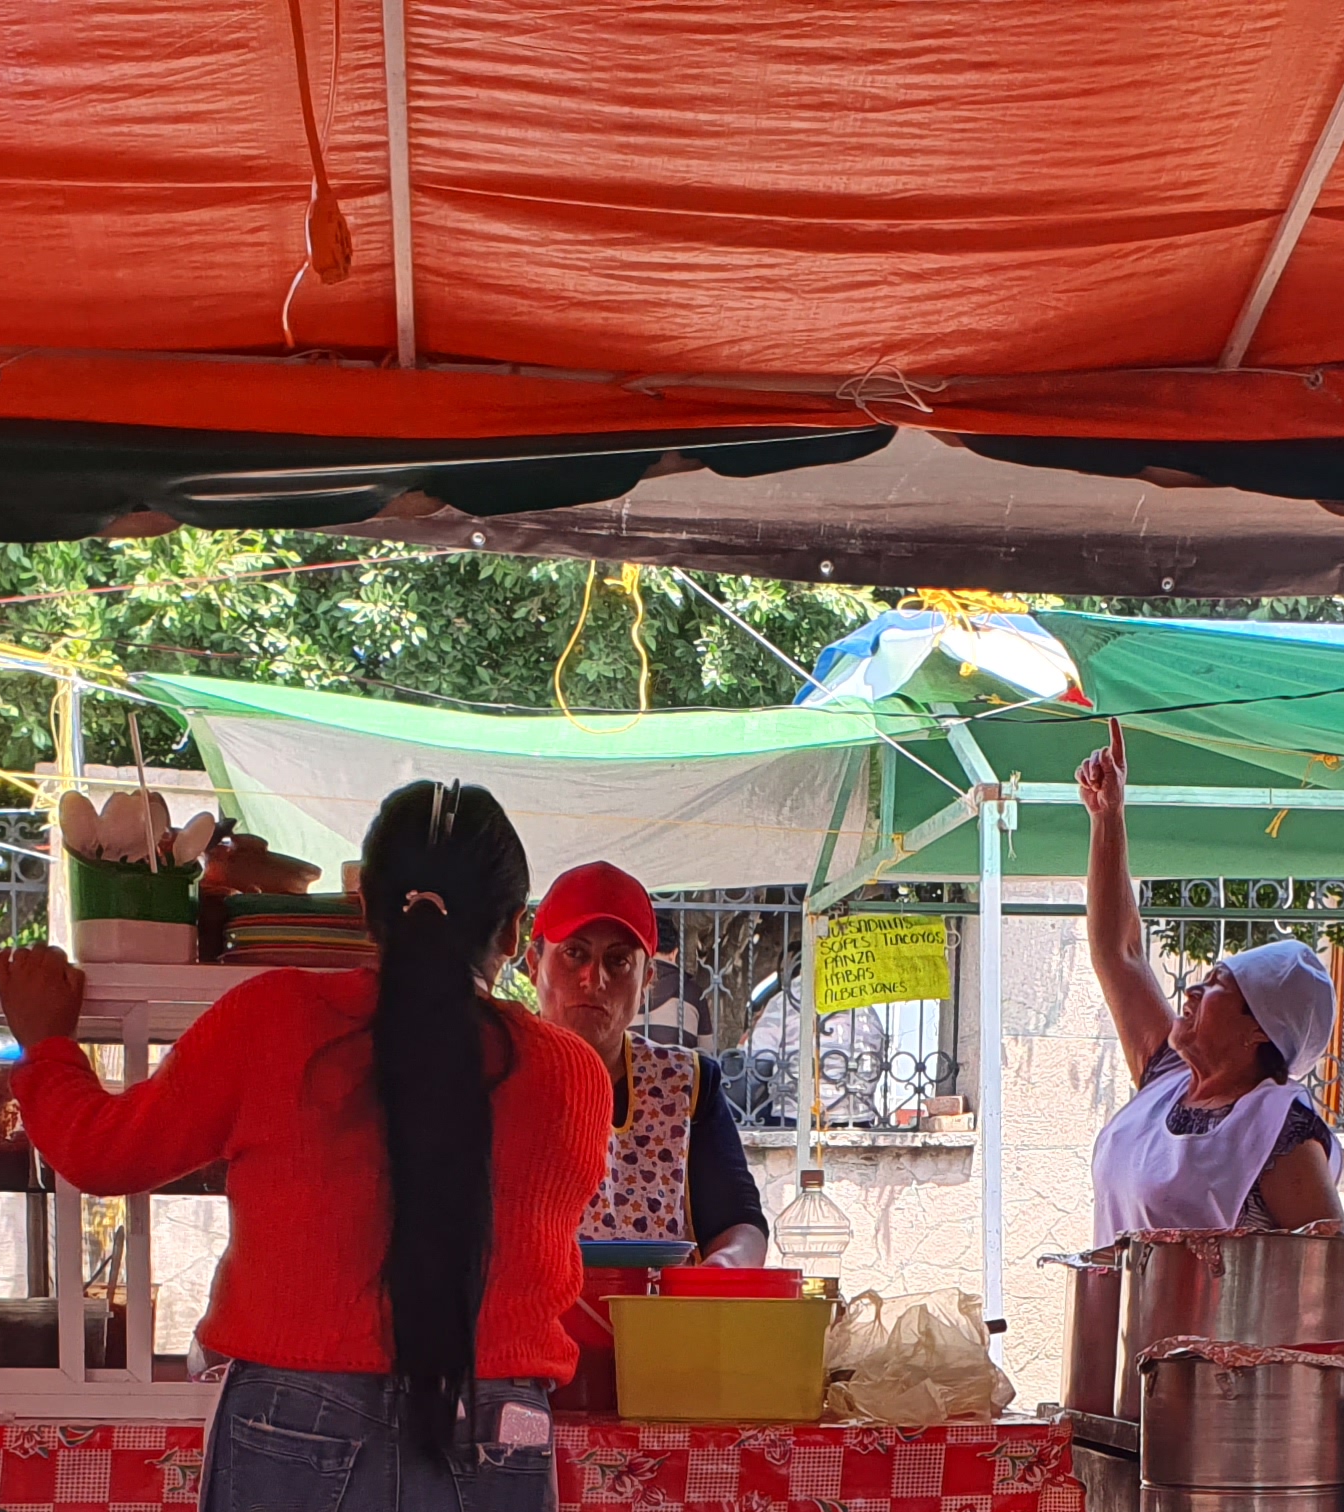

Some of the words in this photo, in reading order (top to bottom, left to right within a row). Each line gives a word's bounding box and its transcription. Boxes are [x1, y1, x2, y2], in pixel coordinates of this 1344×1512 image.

[824, 951, 876, 970] PANZA
[825, 968, 874, 987] HABAS
[824, 982, 907, 1004] ALBERJONES
